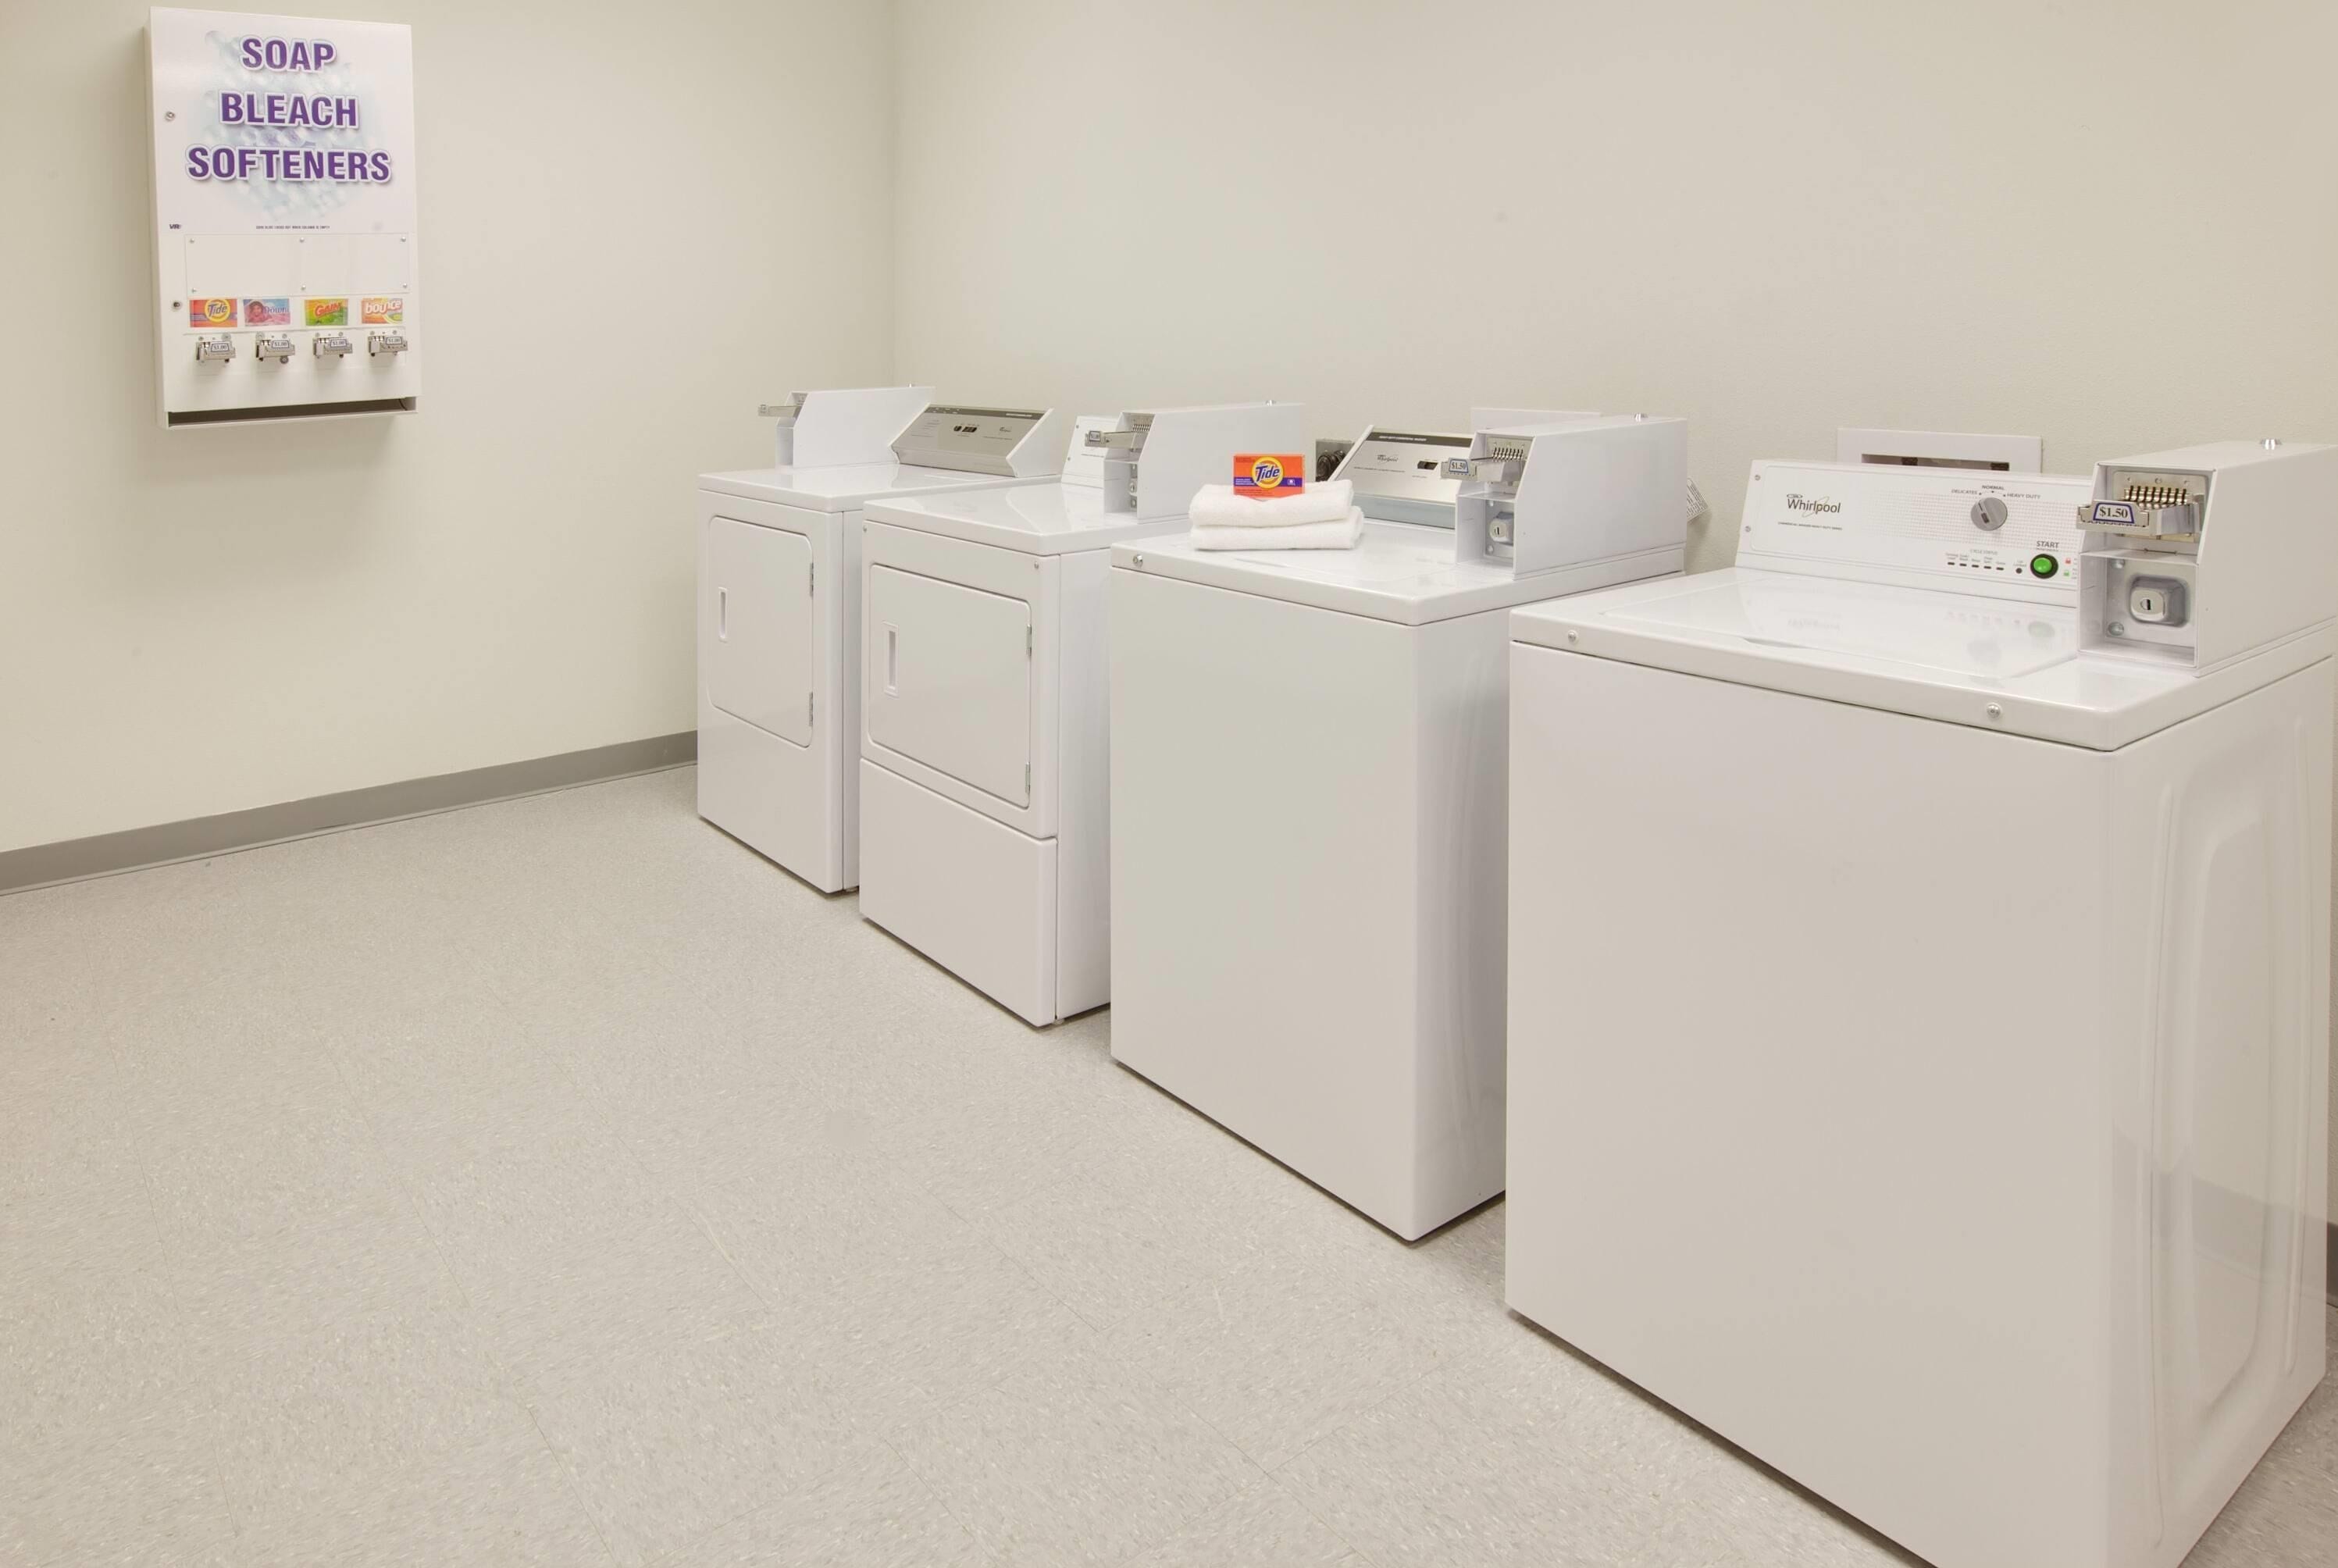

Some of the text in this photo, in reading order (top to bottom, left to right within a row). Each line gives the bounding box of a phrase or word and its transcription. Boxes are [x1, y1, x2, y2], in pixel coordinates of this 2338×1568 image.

[241, 37, 334, 71] SOAP
[220, 92, 358, 127] BLEACH
[187, 147, 390, 181] SOFTENERS
[208, 303, 228, 317] Tide
[365, 299, 402, 315] bounce
[1255, 465, 1280, 483] Tide
[1452, 461, 1467, 470] $1.50
[1787, 498, 1841, 515] Whirlpool
[2099, 506, 2128, 519] $1.50
